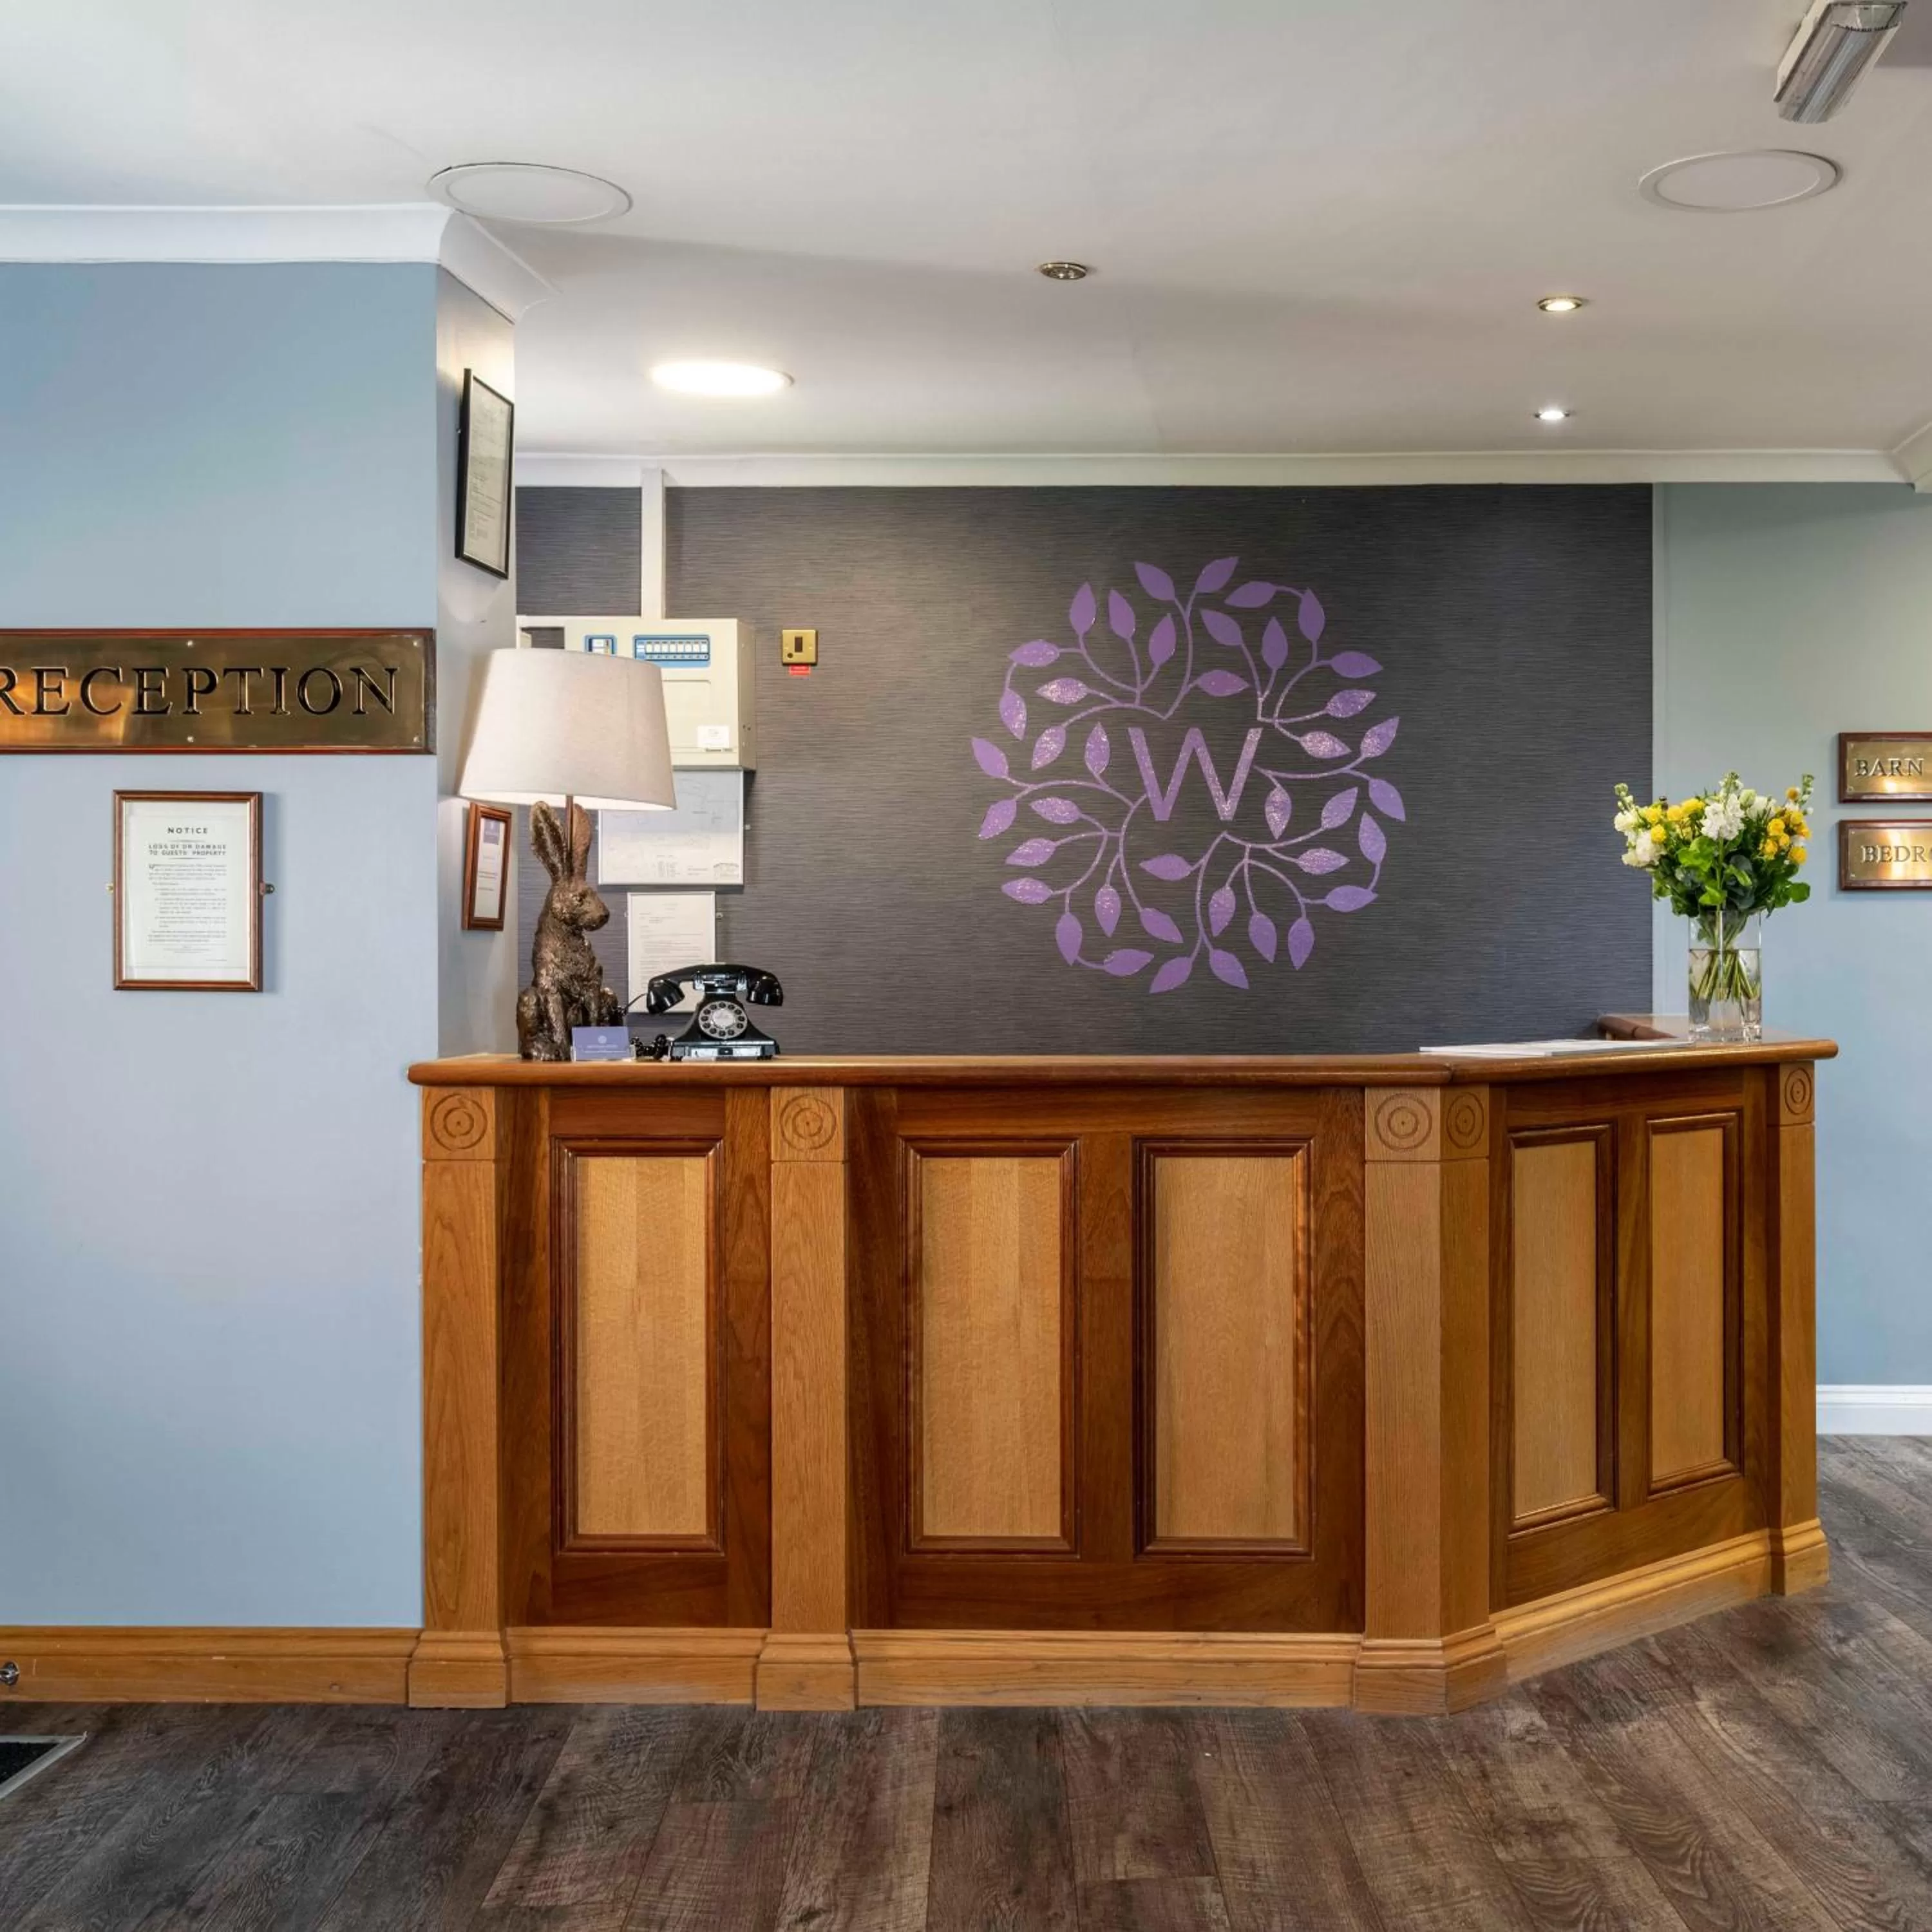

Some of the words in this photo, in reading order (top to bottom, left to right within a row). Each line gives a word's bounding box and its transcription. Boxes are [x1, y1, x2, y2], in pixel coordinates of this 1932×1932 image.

[0, 667, 399, 715] RECEPTION
[1128, 727, 1264, 820] W
[1855, 758, 1924, 777] BARN
[1861, 845, 1932, 863] BEDR
